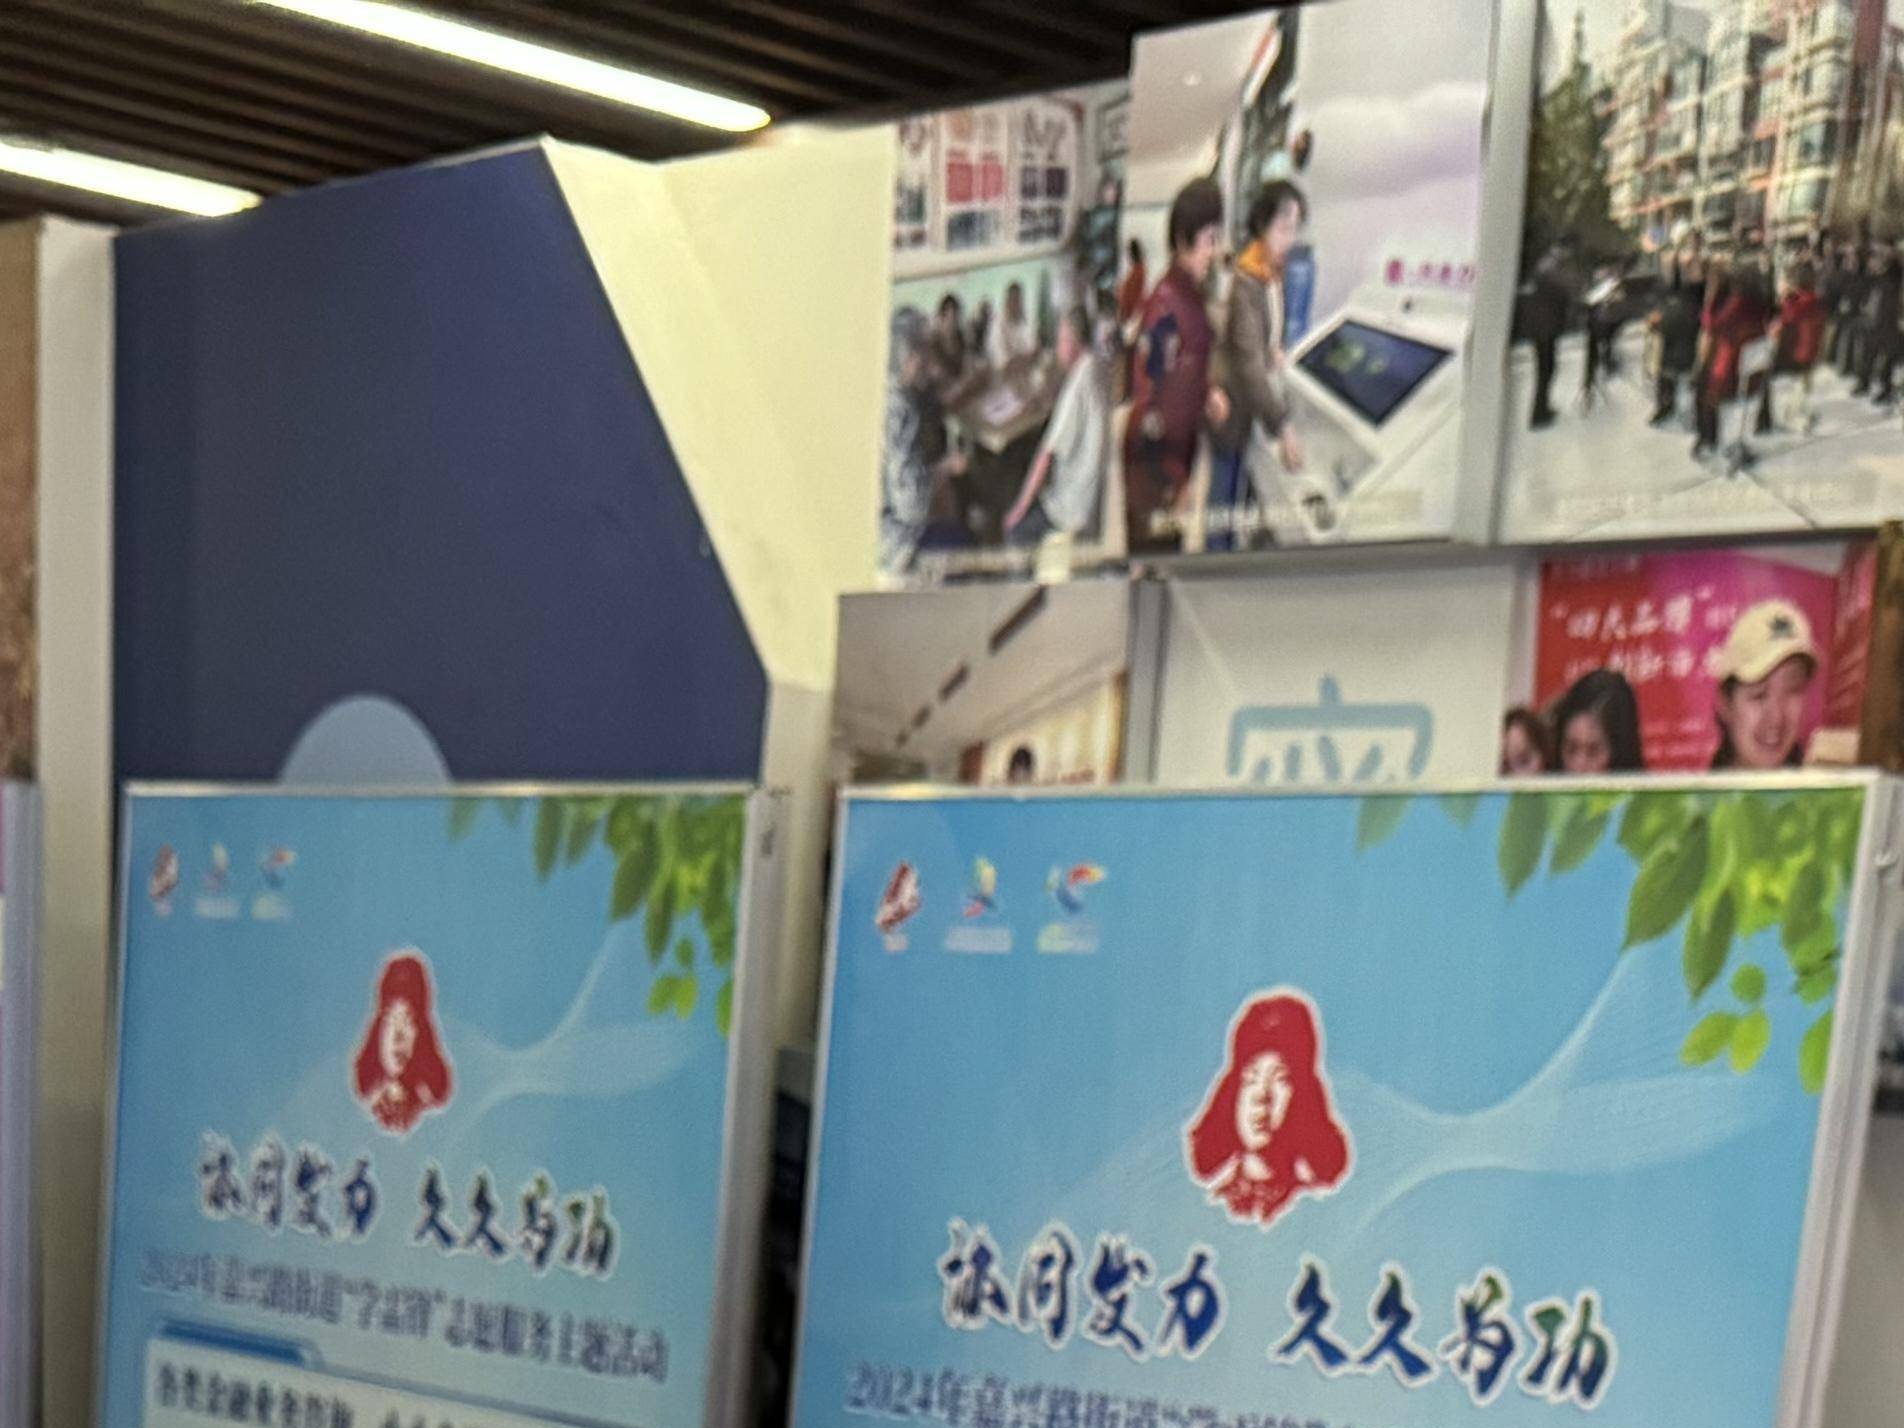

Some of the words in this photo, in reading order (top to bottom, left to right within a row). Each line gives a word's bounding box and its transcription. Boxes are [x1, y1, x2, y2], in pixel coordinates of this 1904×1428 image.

[939, 1220, 1228, 1363] 协同发力
[1274, 1264, 1618, 1406] 久久为功
